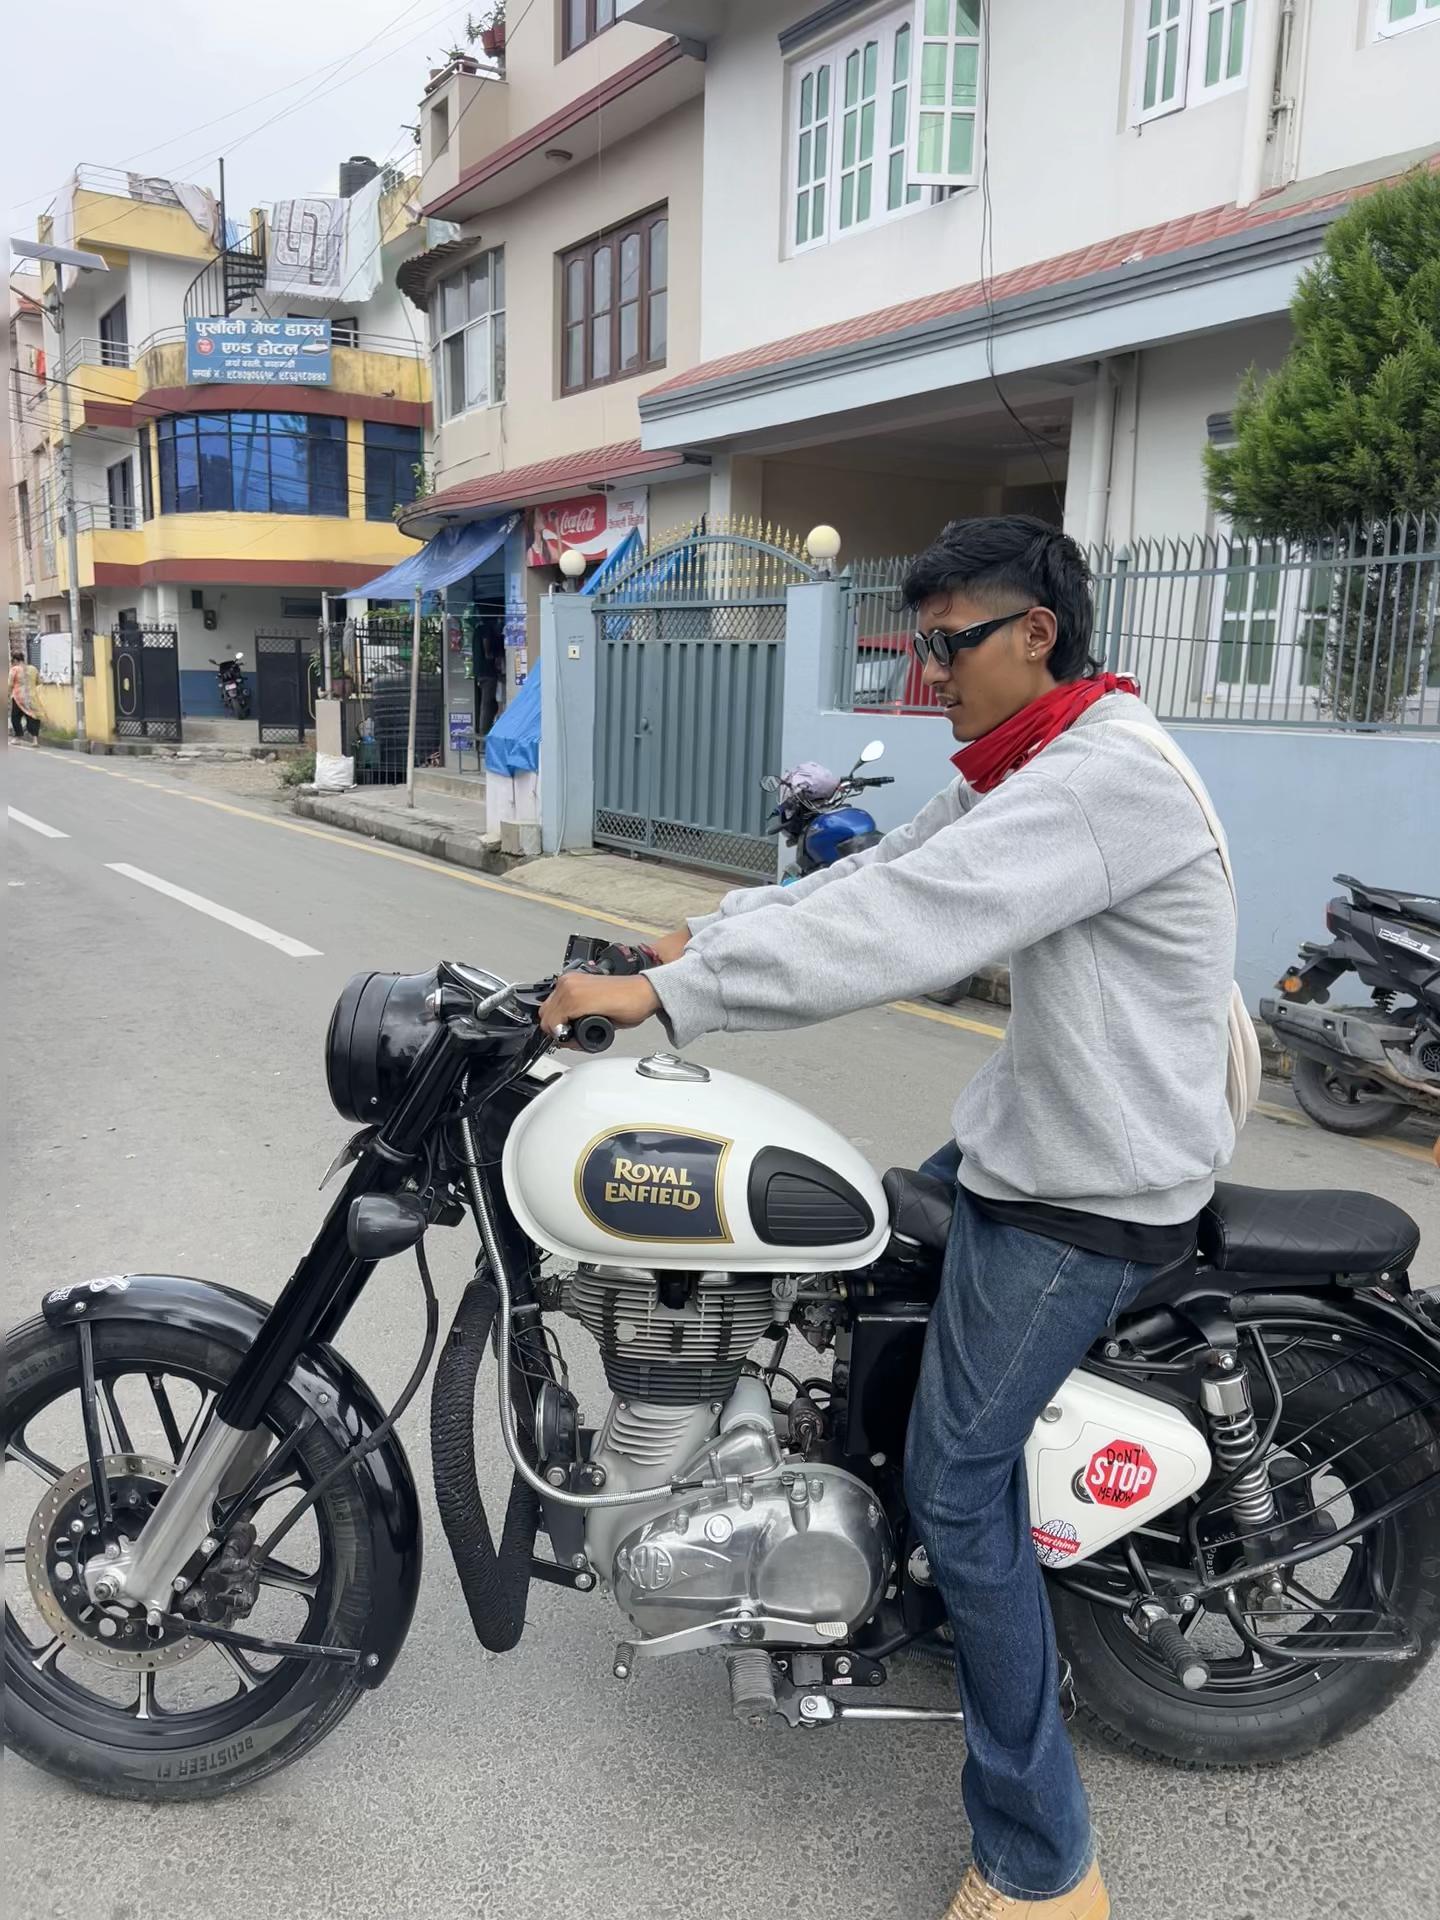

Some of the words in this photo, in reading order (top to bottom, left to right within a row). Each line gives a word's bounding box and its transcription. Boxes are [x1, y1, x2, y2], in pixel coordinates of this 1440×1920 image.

[284, 323, 325, 336] हाउस
[256, 340, 299, 356] होटल
[613, 1158, 692, 1186] ROYAL
[604, 1182, 701, 1211] ENFIELD
[1090, 1456, 1152, 1493] STOP
[1097, 1486, 1112, 1500] ME
[1111, 1489, 1134, 1502] NOW
[1032, 1530, 1077, 1551] overthink
